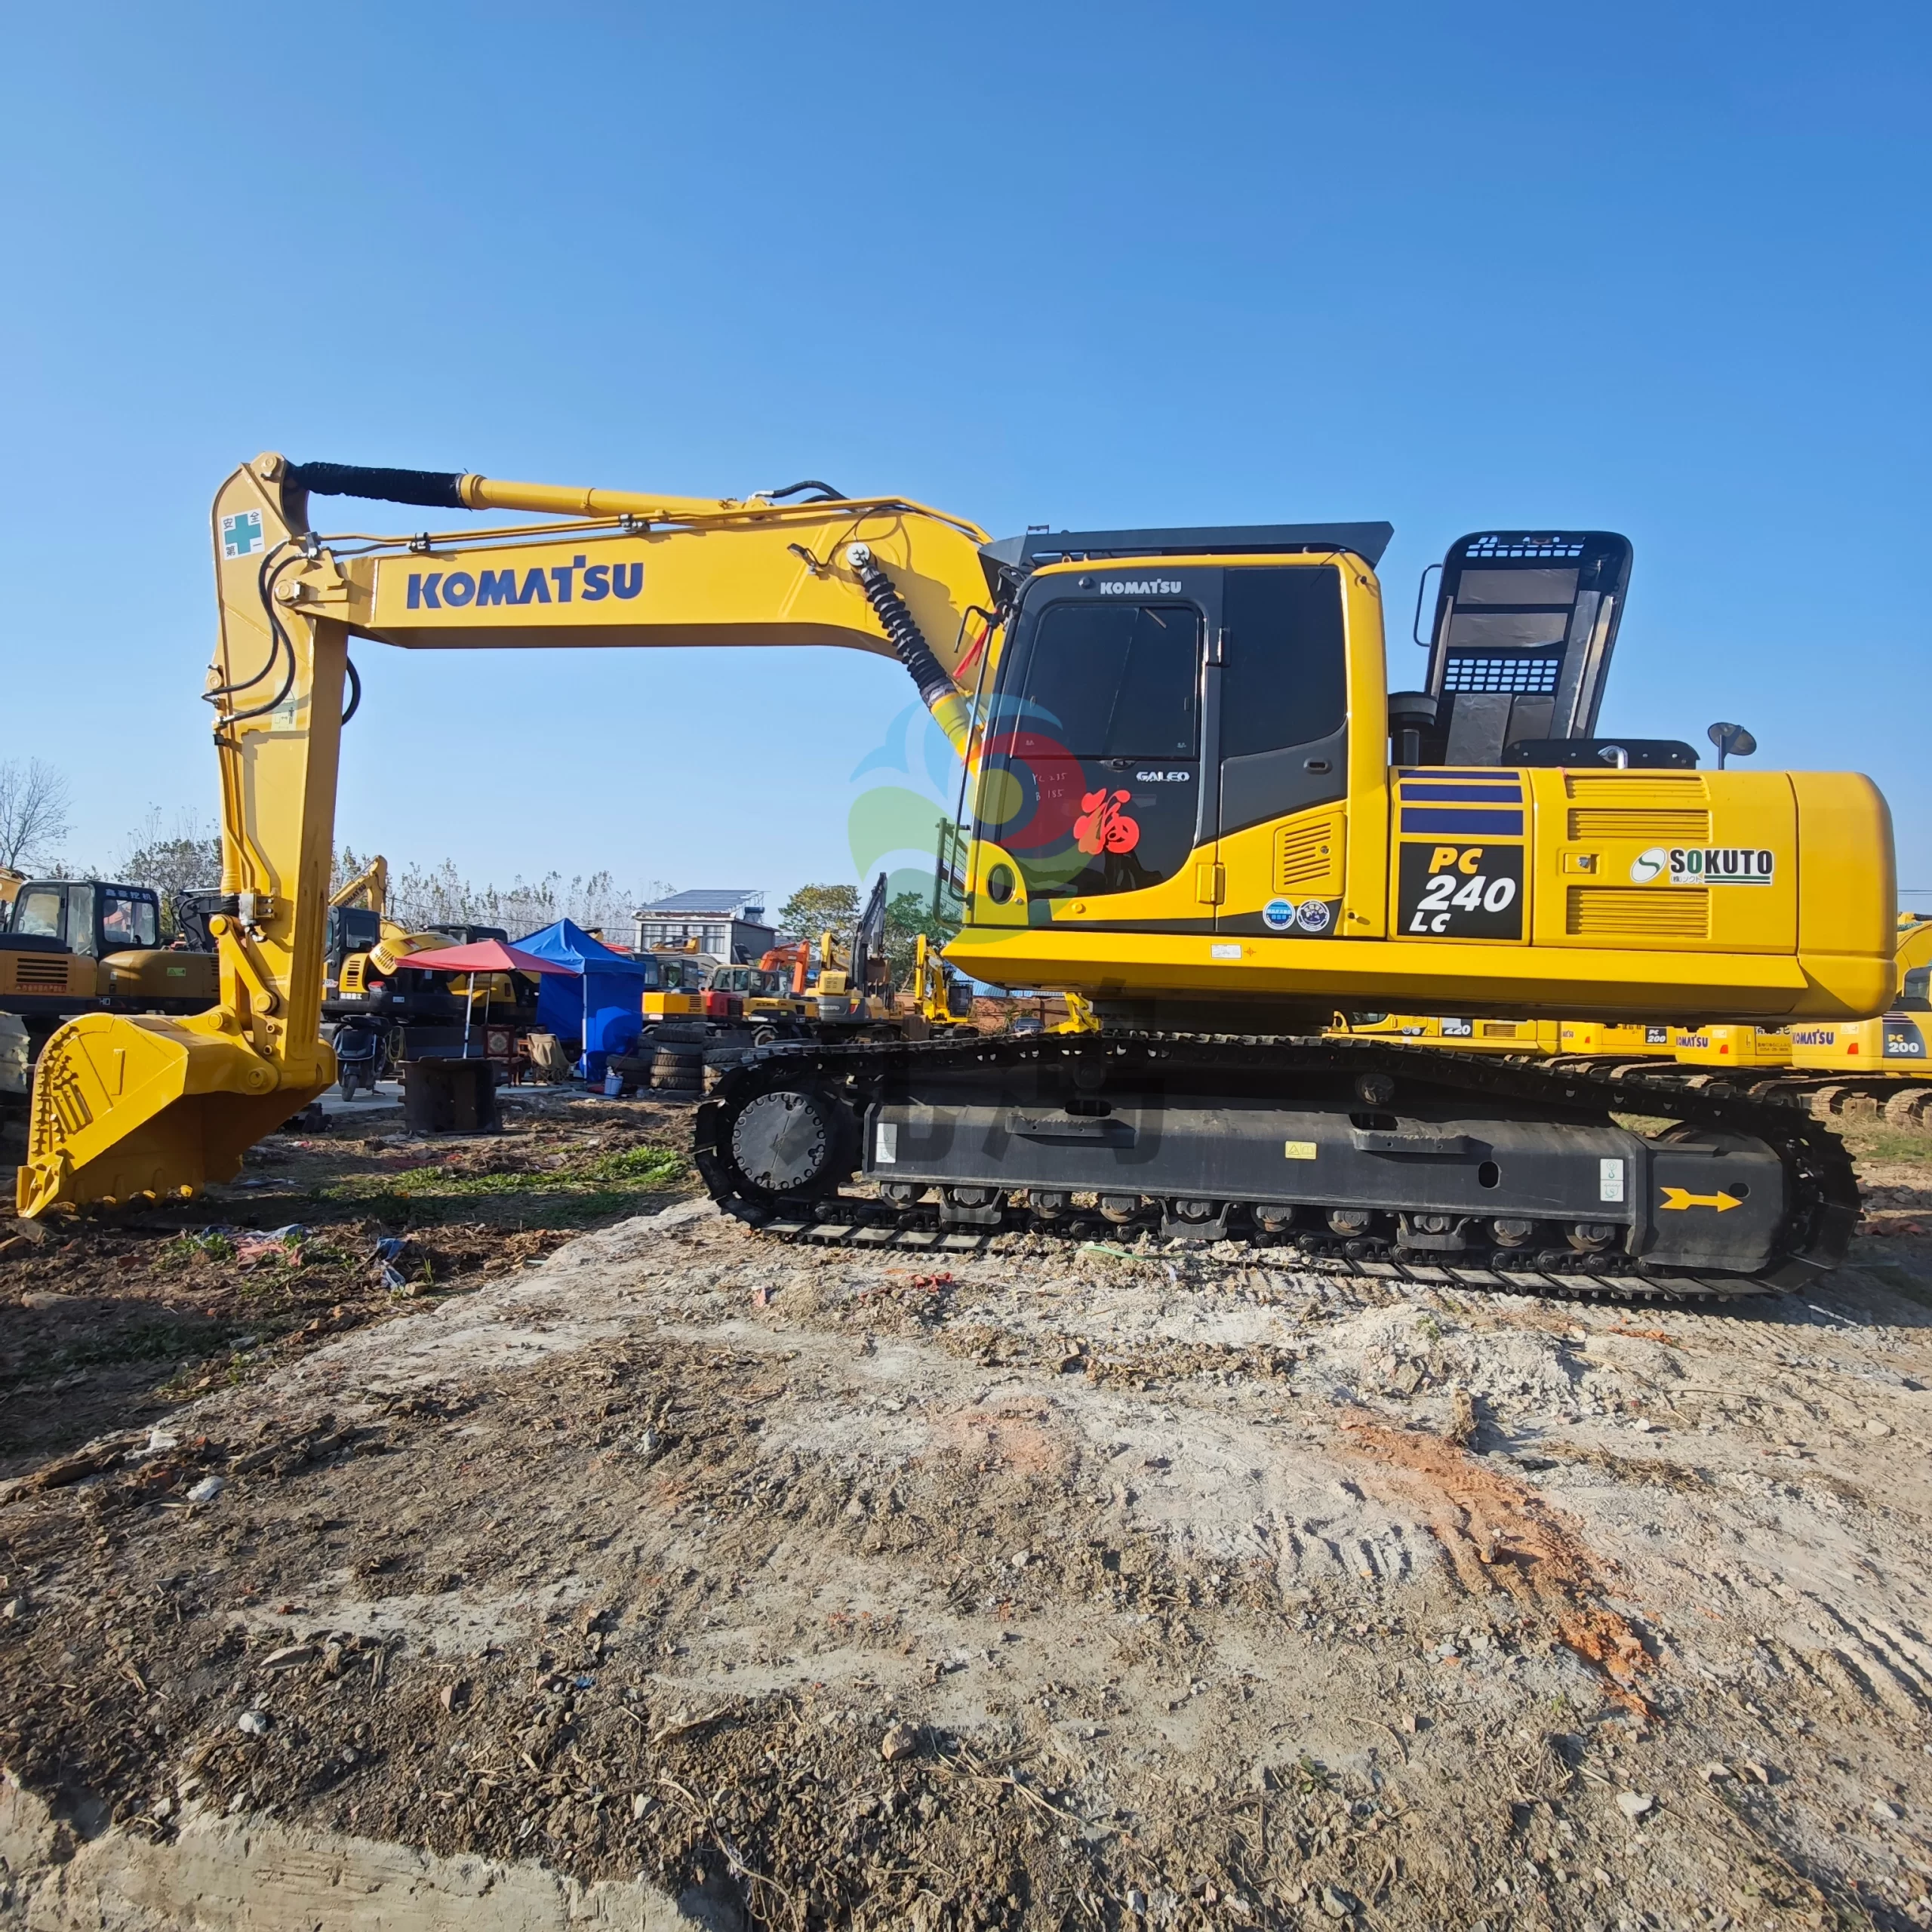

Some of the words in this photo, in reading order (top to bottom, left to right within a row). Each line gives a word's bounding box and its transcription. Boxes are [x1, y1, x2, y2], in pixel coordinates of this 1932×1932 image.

[407, 555, 645, 609] KOMATSU
[1100, 577, 1182, 595] KOMATSU
[1136, 771, 1190, 782] GALEO
[1428, 847, 1483, 875] PC
[1670, 849, 1773, 875] SOKUTO
[1417, 875, 1516, 912] 240
[1409, 912, 1451, 933] LC
[1647, 1035, 1666, 1043] 200
[1792, 1029, 1834, 1044] KOMATSU
[1888, 1042, 1919, 1053] 200
